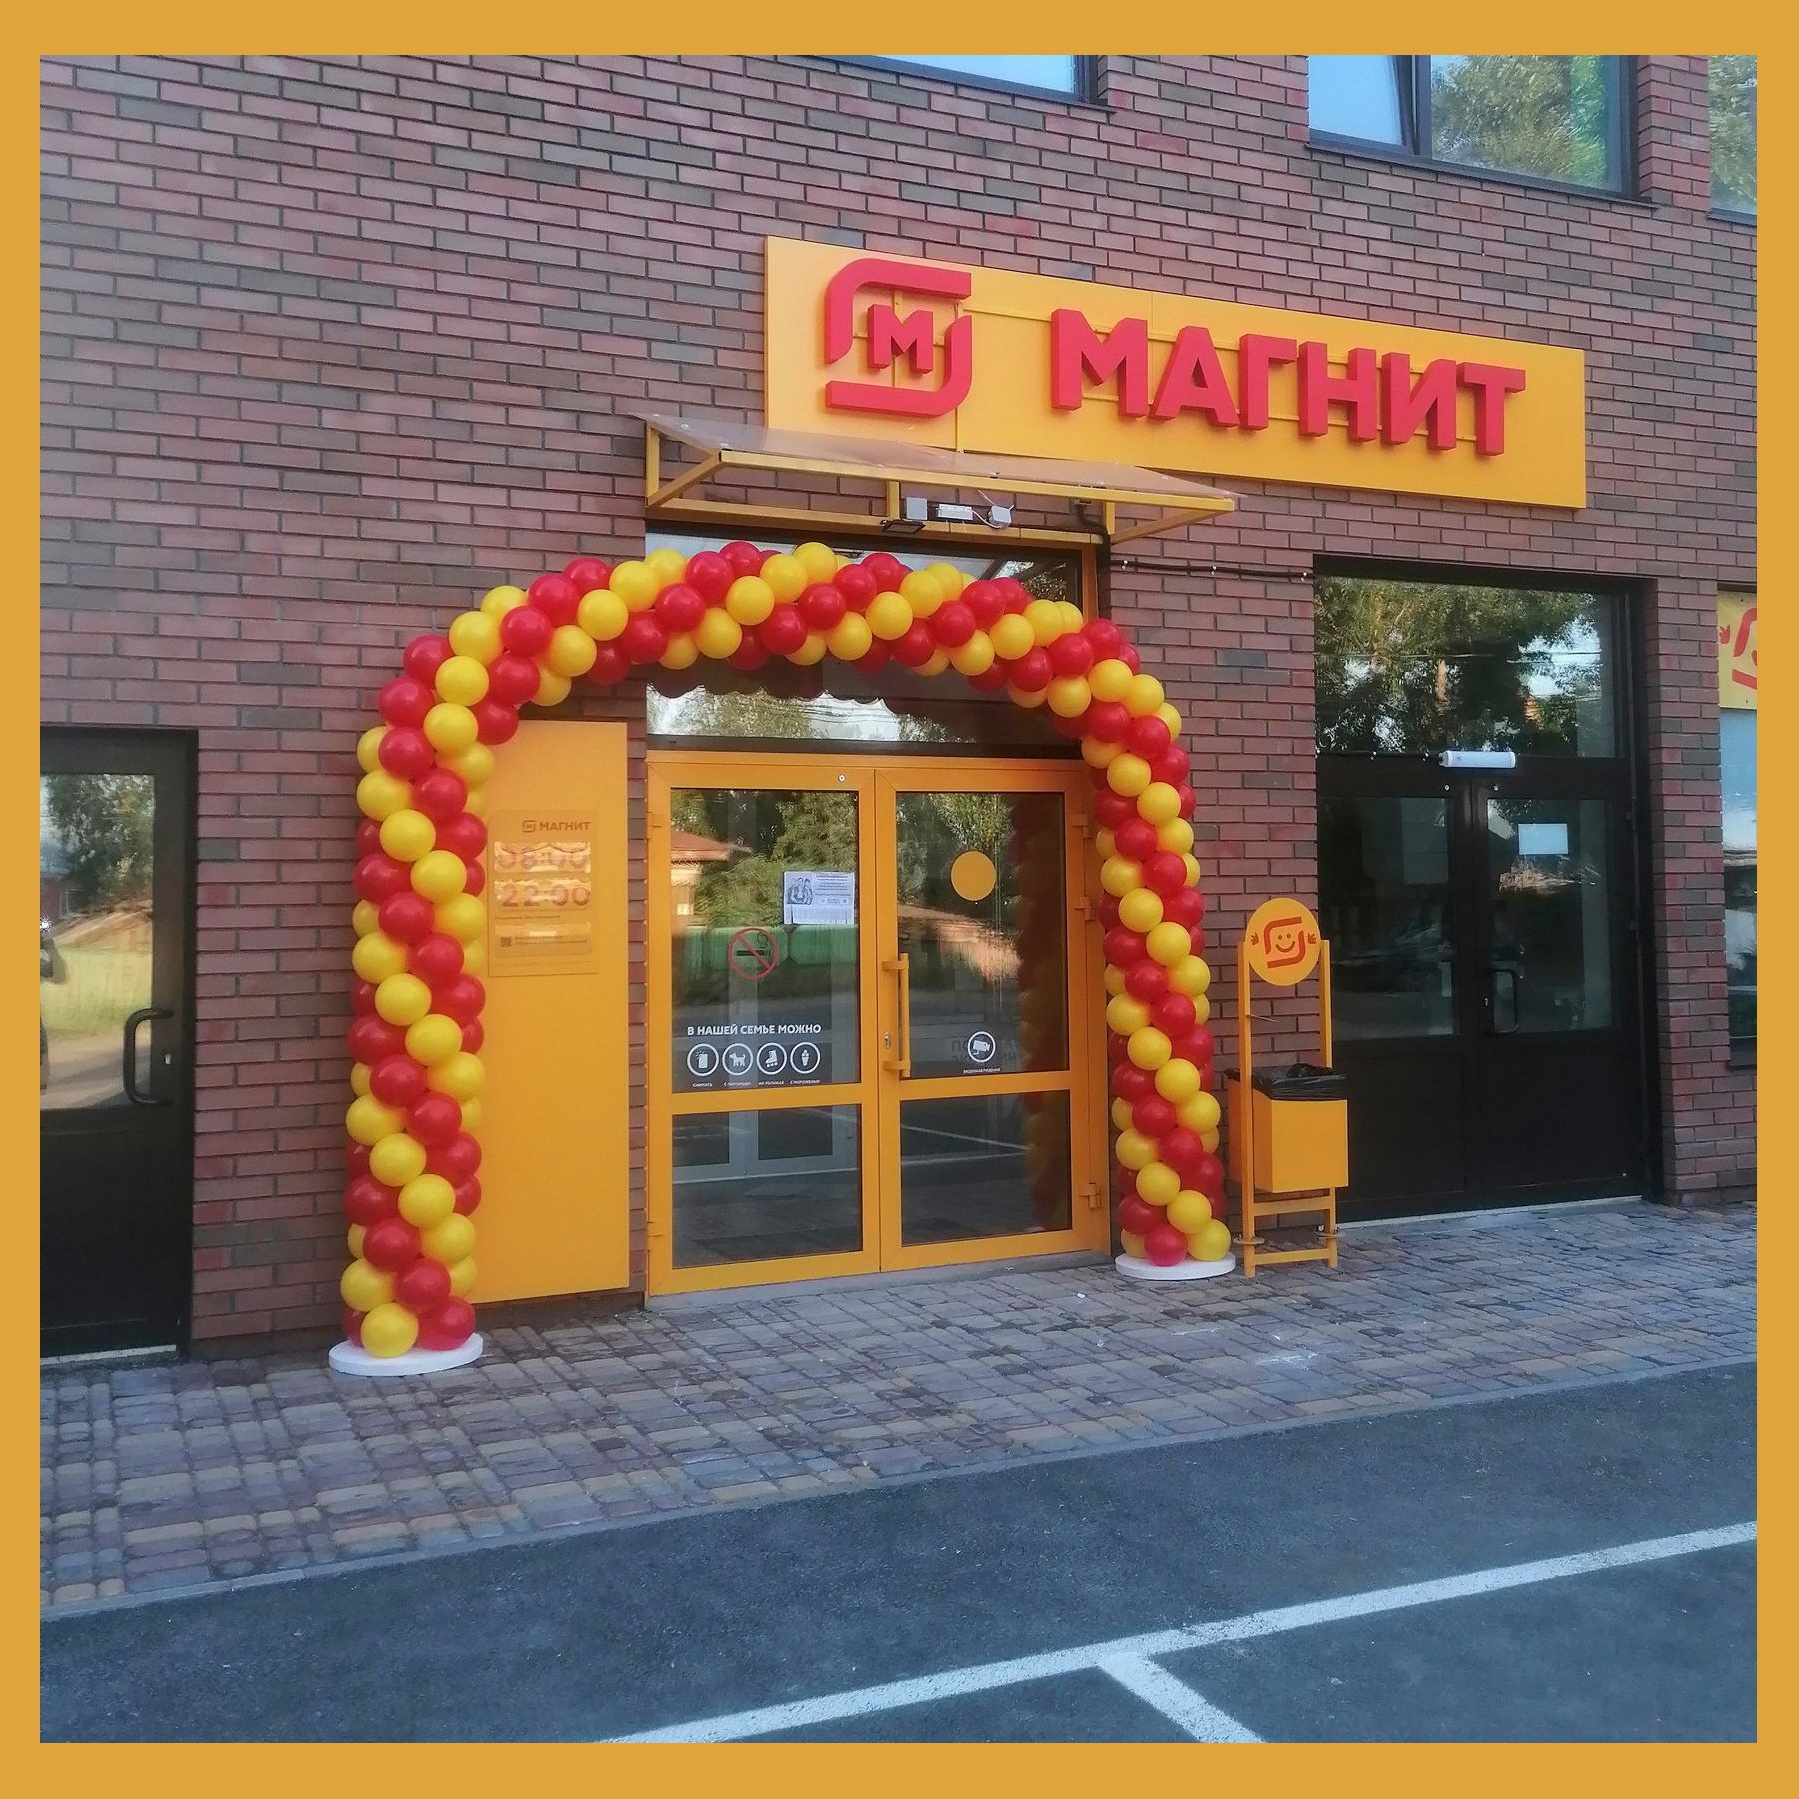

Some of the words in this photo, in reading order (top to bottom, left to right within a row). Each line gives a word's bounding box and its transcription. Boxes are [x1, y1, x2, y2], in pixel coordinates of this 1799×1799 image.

[1051, 308, 1527, 457] МАГНИТ
[539, 821, 591, 832] МАГНИТ
[687, 1026, 695, 1036] В
[697, 1023, 738, 1035] НАШЕЙ
[740, 1025, 775, 1035] СЕМЬЕ
[778, 1024, 822, 1034] МОЖНО
